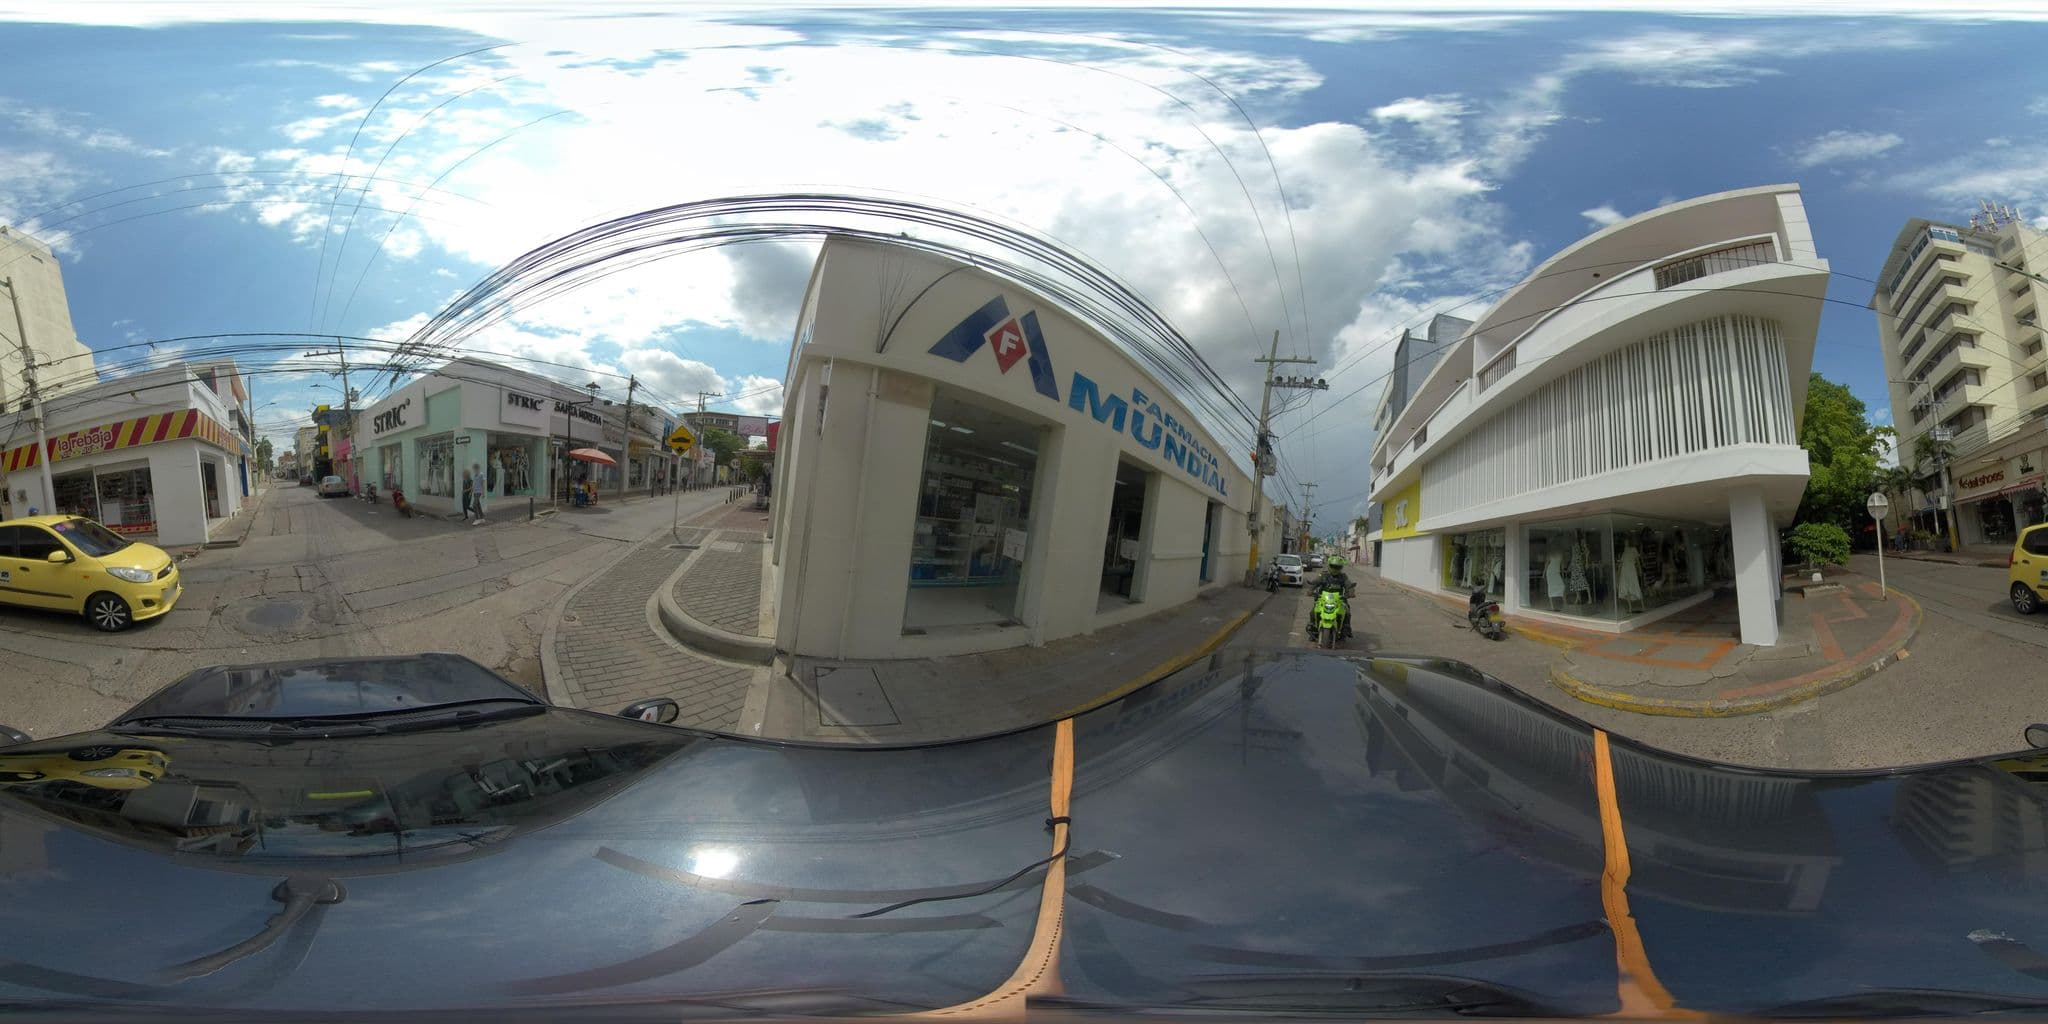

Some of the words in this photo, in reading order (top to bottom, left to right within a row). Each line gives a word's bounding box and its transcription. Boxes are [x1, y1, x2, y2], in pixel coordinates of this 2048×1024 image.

[1000, 330, 1020, 355] F
[373, 403, 407, 435] STRIC
[1069, 371, 1228, 496] MUNDIAL
[1133, 388, 1218, 468] FARMACIA
[70, 430, 113, 449] rebaja
